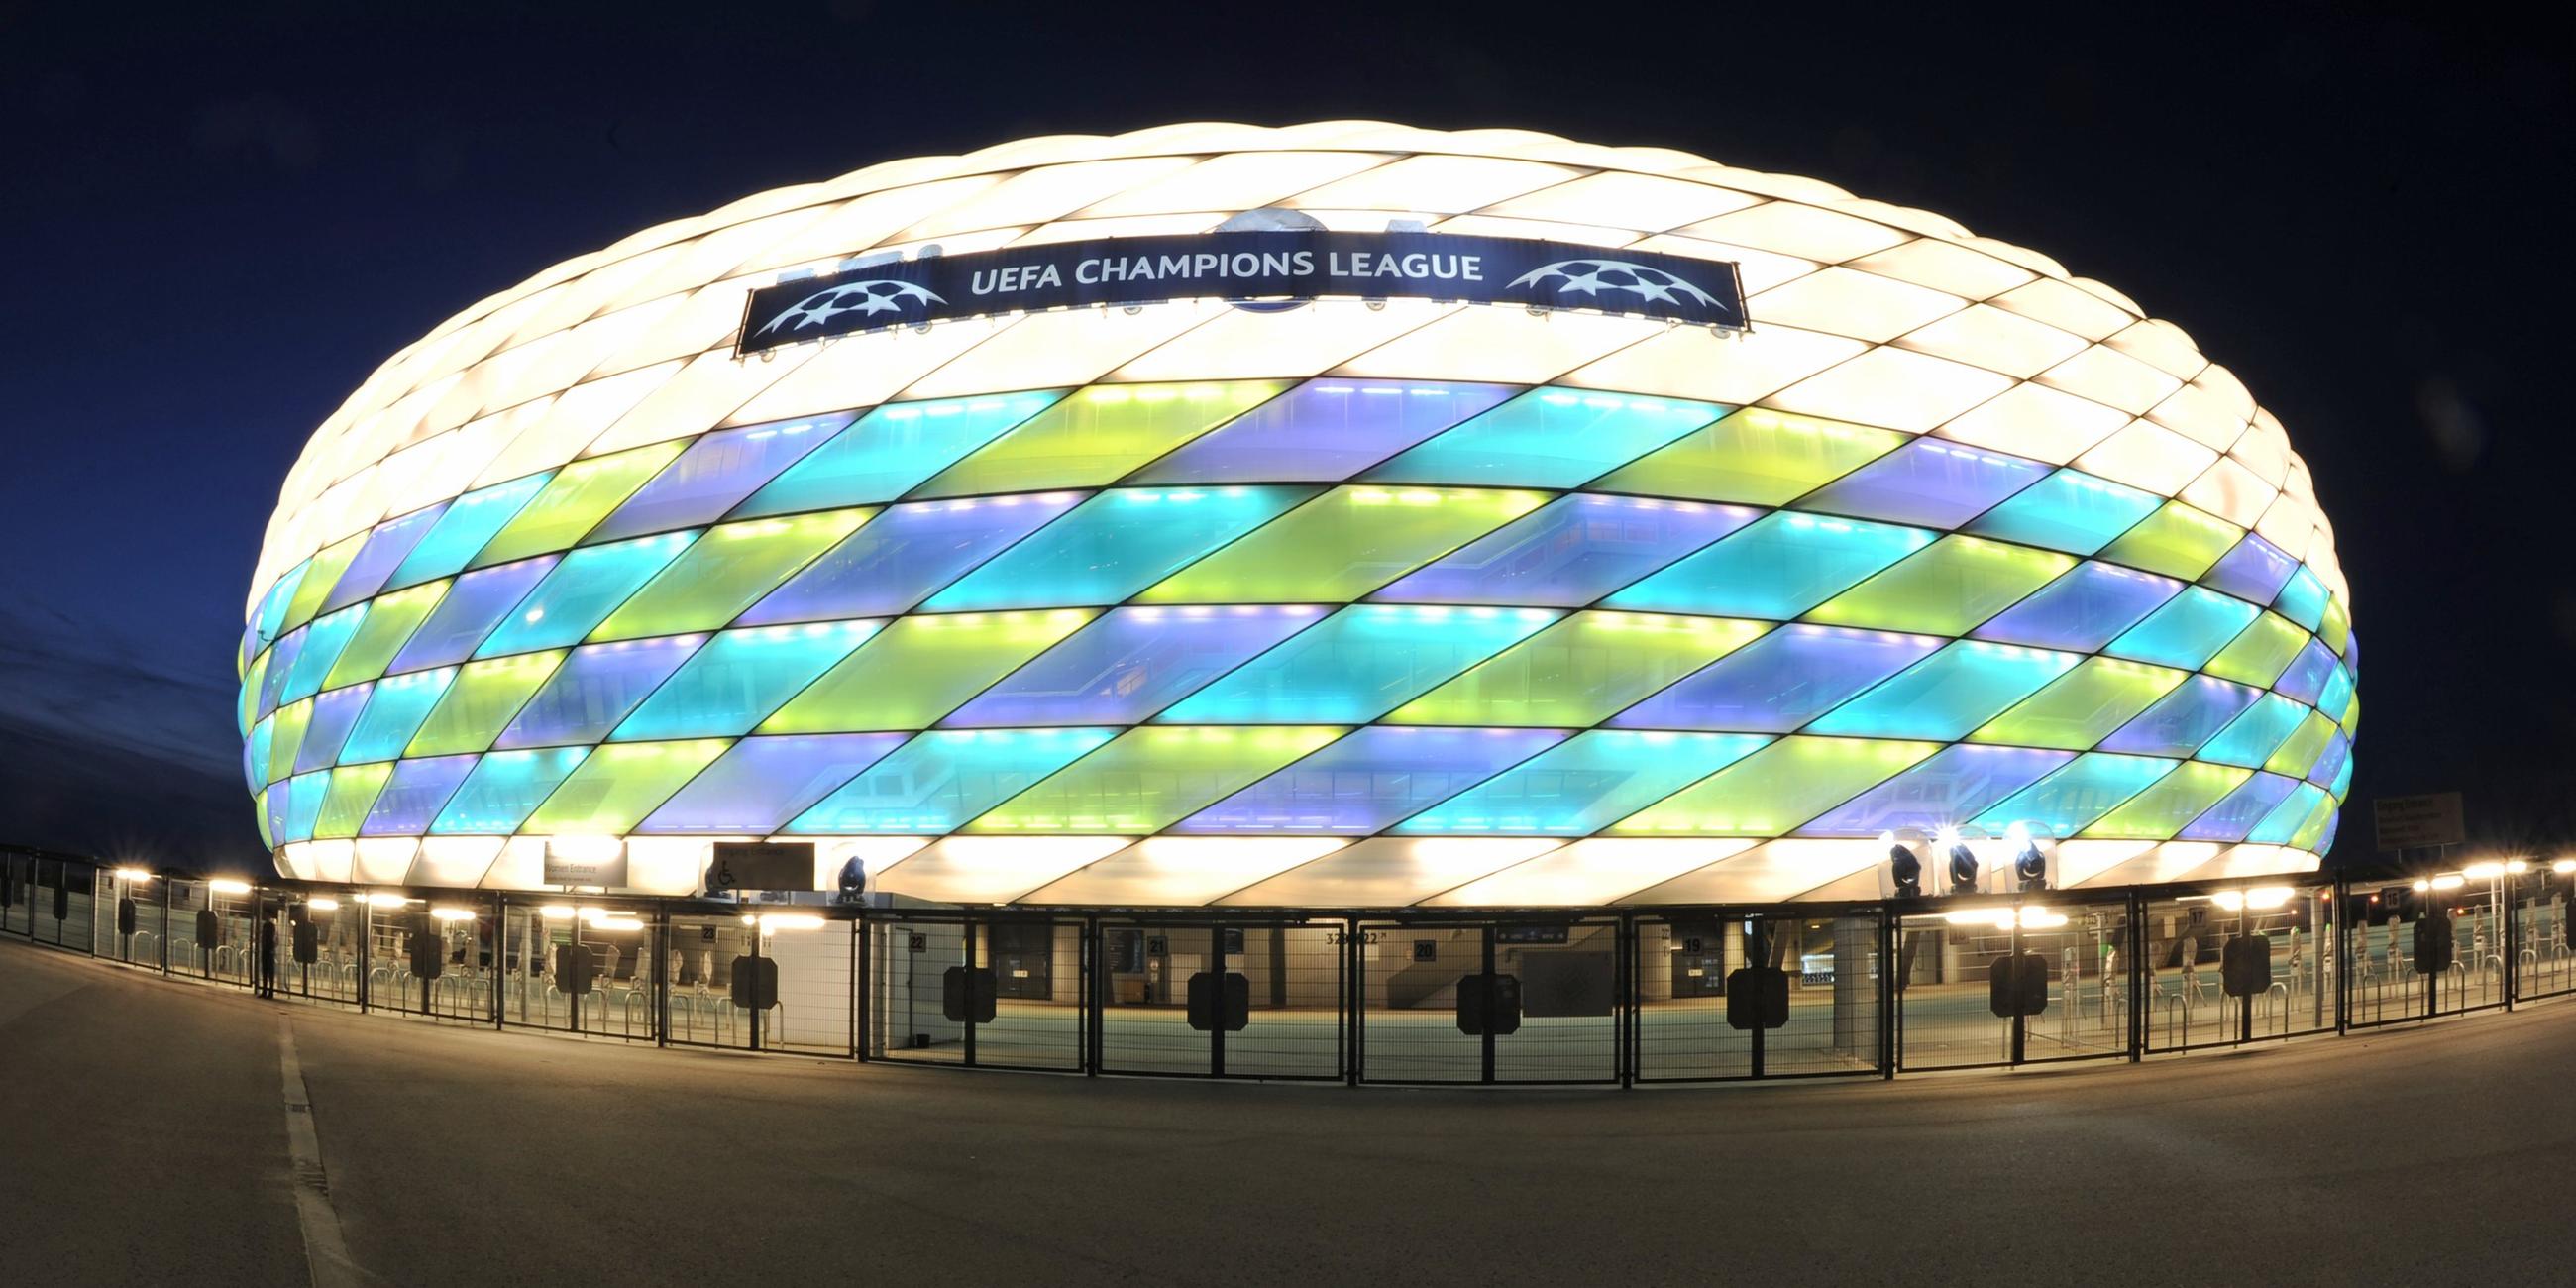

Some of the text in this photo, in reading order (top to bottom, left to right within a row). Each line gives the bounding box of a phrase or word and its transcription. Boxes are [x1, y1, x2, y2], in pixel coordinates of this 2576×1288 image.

[971, 251, 1484, 295] UEFA CHAMPIONS LEAGUE
[2193, 911, 2203, 924] 17
[703, 927, 714, 940] 23
[911, 936, 923, 949] 22
[1150, 939, 1163, 953] 21
[1686, 938, 1700, 952] 19
[1417, 943, 1432, 957] 20
